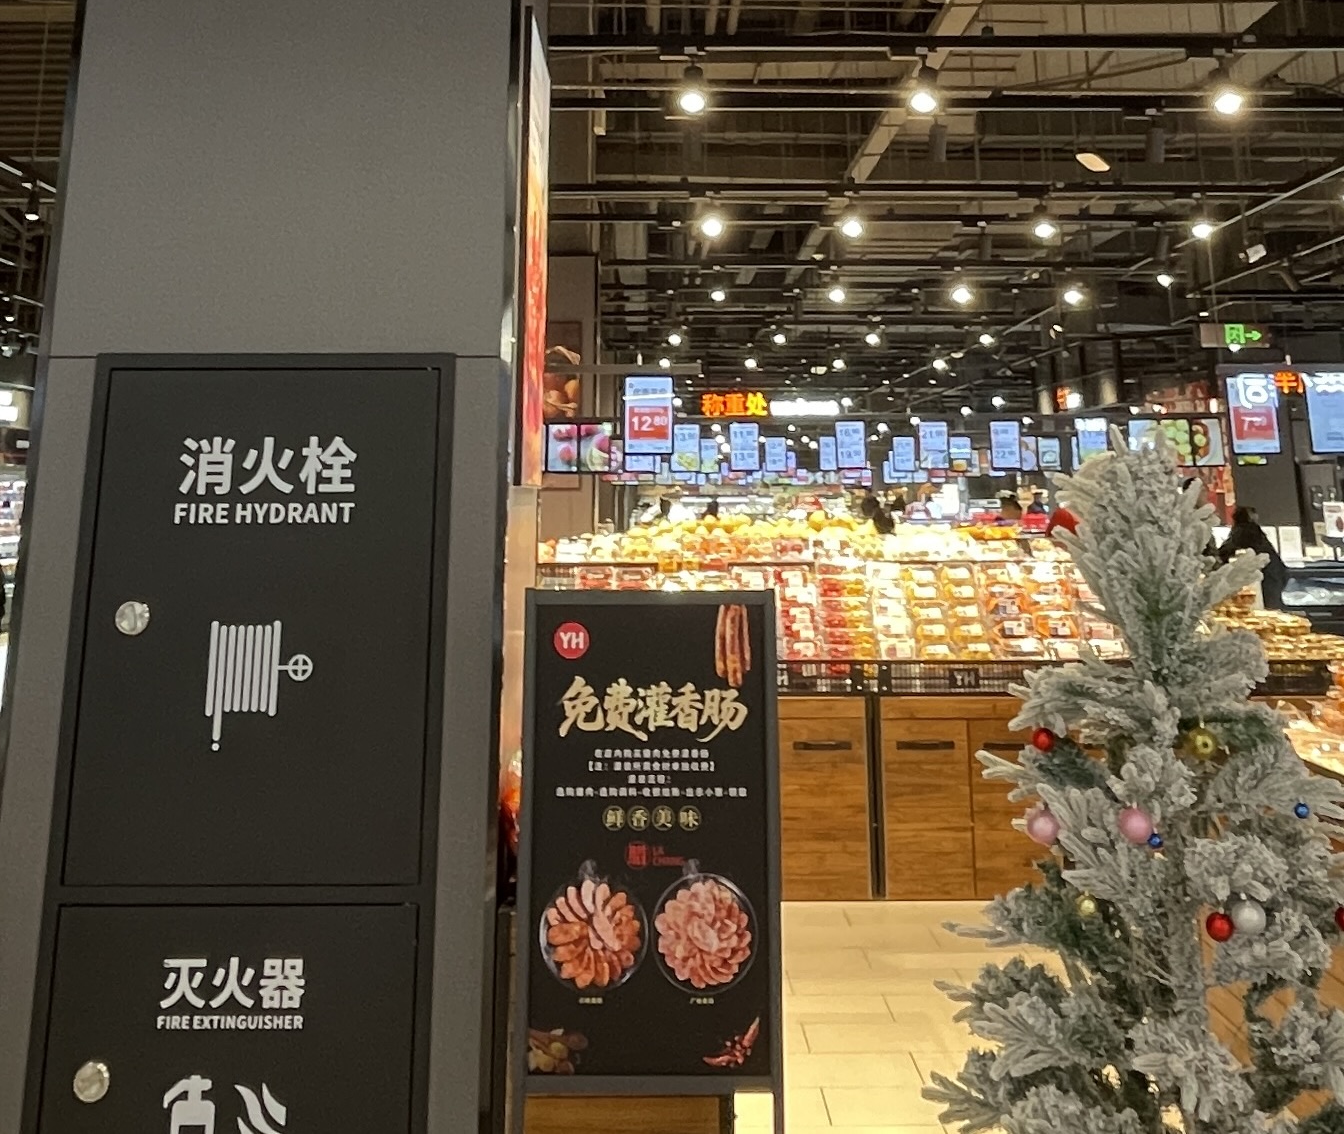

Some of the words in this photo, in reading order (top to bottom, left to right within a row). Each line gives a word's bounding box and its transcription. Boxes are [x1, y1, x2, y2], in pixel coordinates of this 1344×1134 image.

[701, 391, 768, 417] 称重处
[178, 435, 358, 496] 消火栓
[173, 501, 229, 525] FIRE
[234, 501, 356, 525] HYDRANT
[559, 631, 585, 650] YH
[557, 675, 748, 743] 免费灌香肠
[160, 957, 305, 1011] 灭火器
[157, 1015, 190, 1031] FIRE
[192, 1015, 304, 1031] EXTINGUISHER
